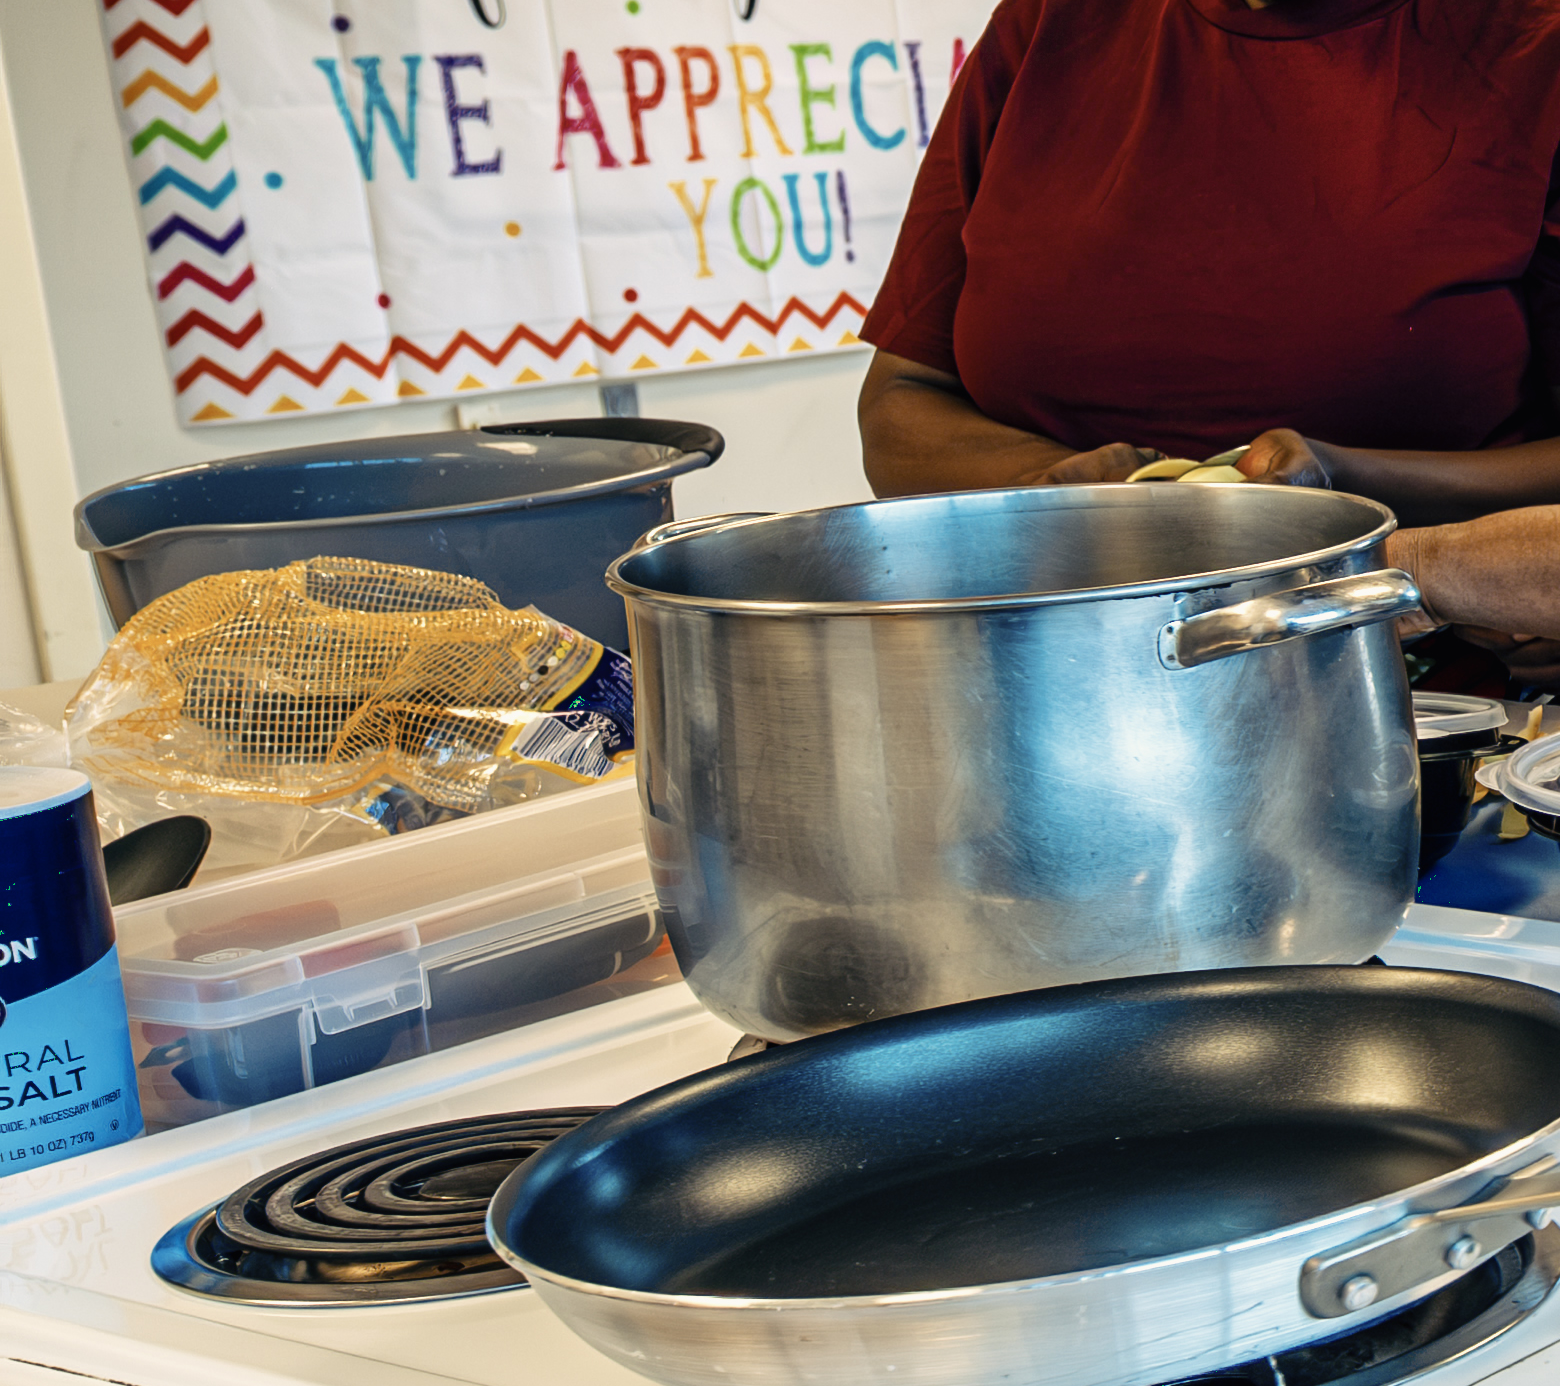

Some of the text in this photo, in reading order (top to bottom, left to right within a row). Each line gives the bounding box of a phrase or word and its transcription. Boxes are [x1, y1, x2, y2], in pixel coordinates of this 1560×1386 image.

[314, 53, 505, 182] WE
[670, 170, 857, 279] YOU!
[10, 1148, 26, 1160] LB
[30, 1145, 44, 1155] 10
[48, 1138, 67, 1151] OZ)
[70, 1131, 95, 1144] 737g
[39, 1102, 91, 1124] NECESSARY
